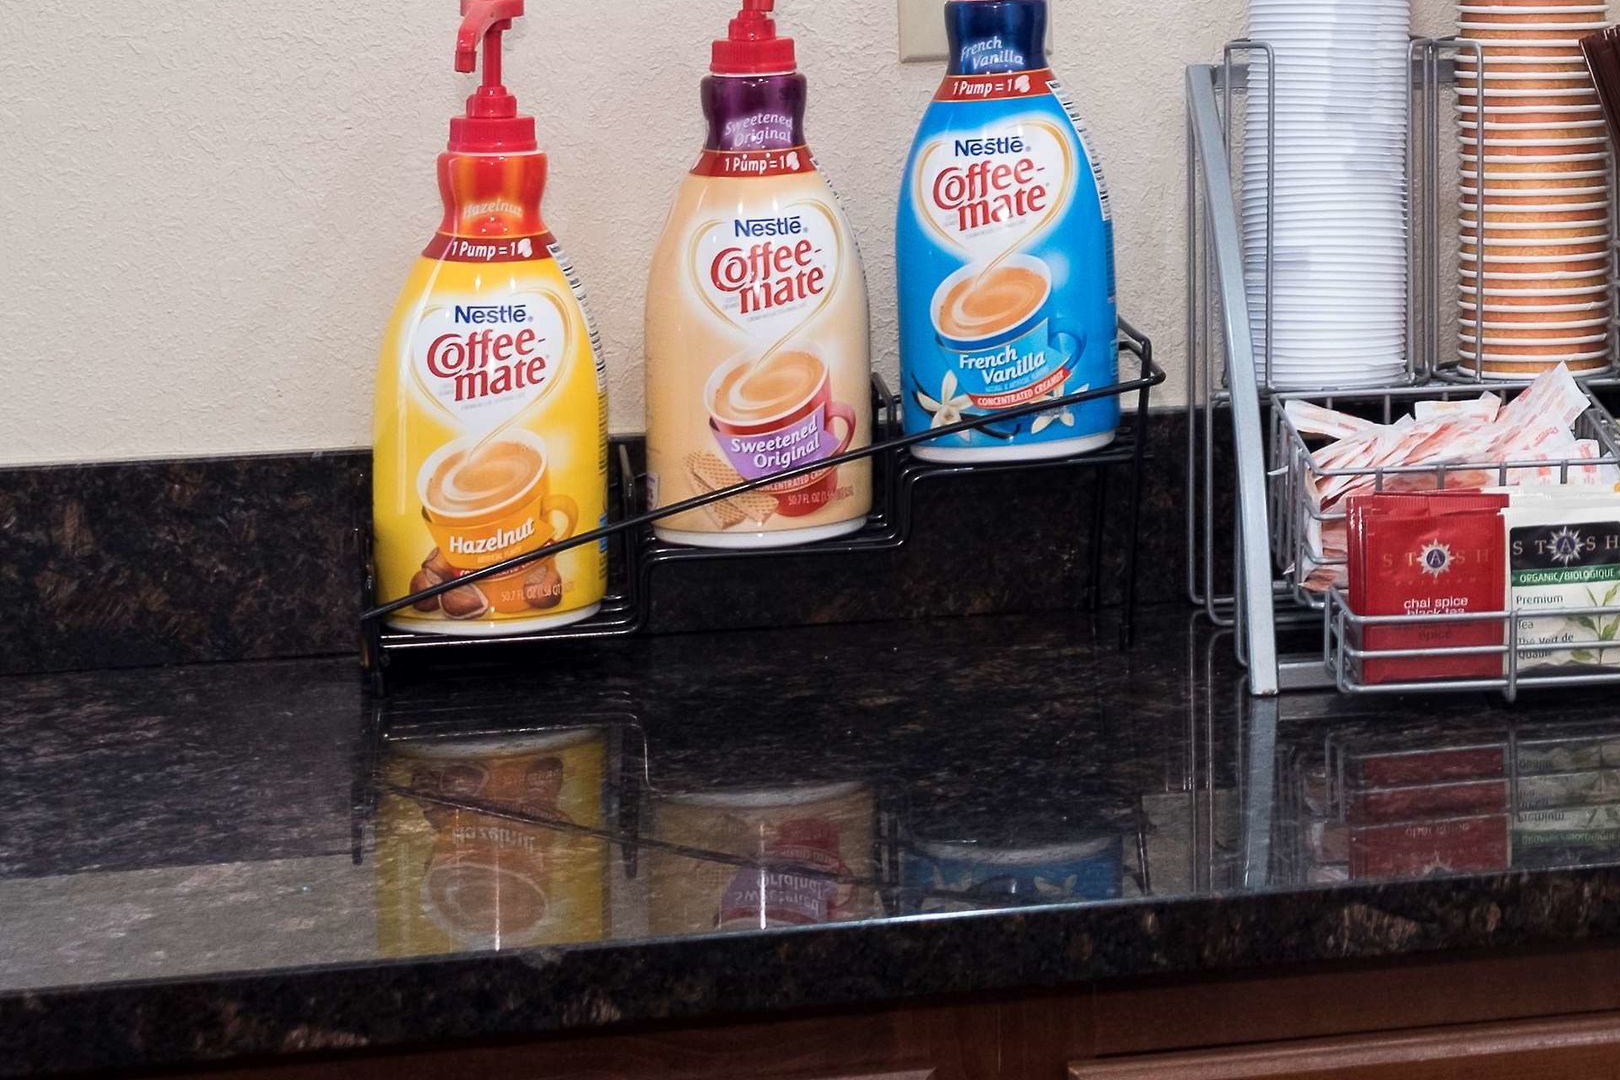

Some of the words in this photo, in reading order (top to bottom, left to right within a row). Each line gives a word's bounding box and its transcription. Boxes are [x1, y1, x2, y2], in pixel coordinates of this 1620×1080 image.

[960, 35, 1003, 62] French
[972, 50, 1025, 70] Vanilla
[959, 80, 993, 98] Pump
[732, 156, 768, 175] Pump
[957, 184, 1047, 232] mate
[459, 240, 497, 261] Pump
[739, 266, 825, 314] mate
[959, 344, 1018, 370] French
[981, 350, 1047, 386] Vanilla
[454, 355, 546, 402] mate
[730, 414, 819, 454] Sweetened
[752, 431, 820, 469] Original
[448, 517, 535, 555] Hazelnut
[1512, 534, 1619, 556] STASH
[1403, 597, 1430, 609] chai
[1434, 595, 1469, 609] spice
[1516, 594, 1564, 605] Premium
